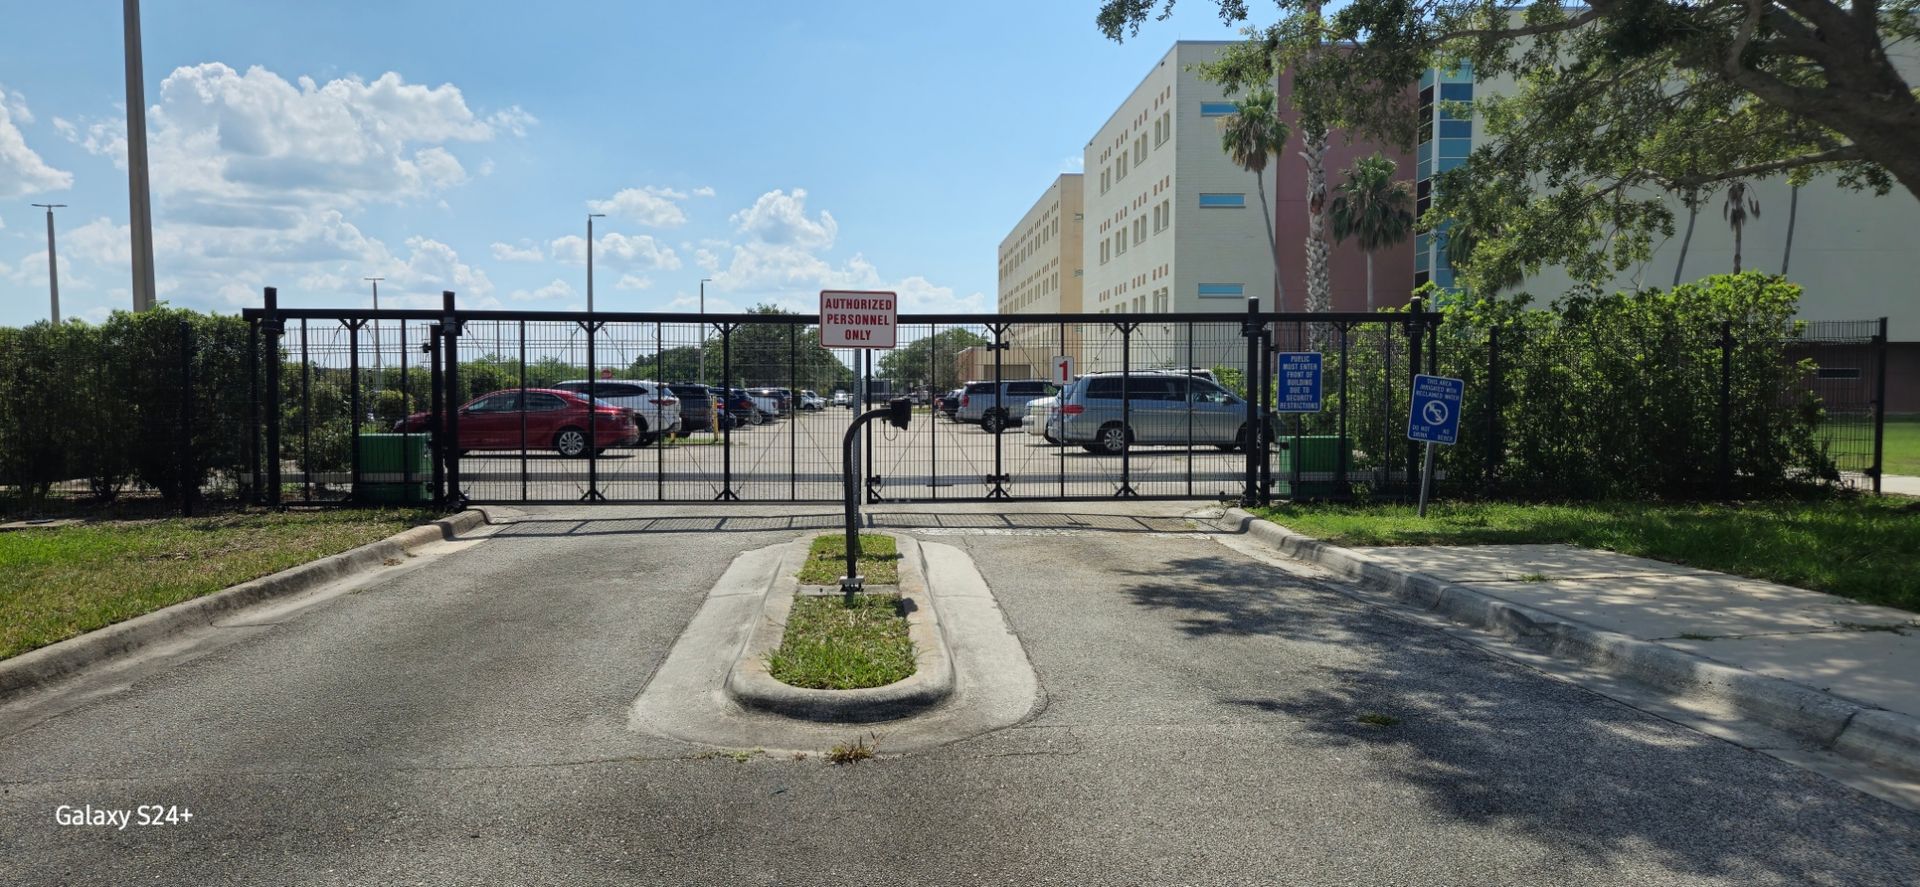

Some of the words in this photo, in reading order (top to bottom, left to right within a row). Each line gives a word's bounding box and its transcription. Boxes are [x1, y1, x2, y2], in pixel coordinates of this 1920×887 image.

[825, 298, 892, 310] AUTHORIZED
[827, 314, 889, 326] PERSONNEL
[845, 329, 871, 340] ONLY
[1059, 360, 1068, 381] 1
[1416, 390, 1443, 399] RECLAIMED
